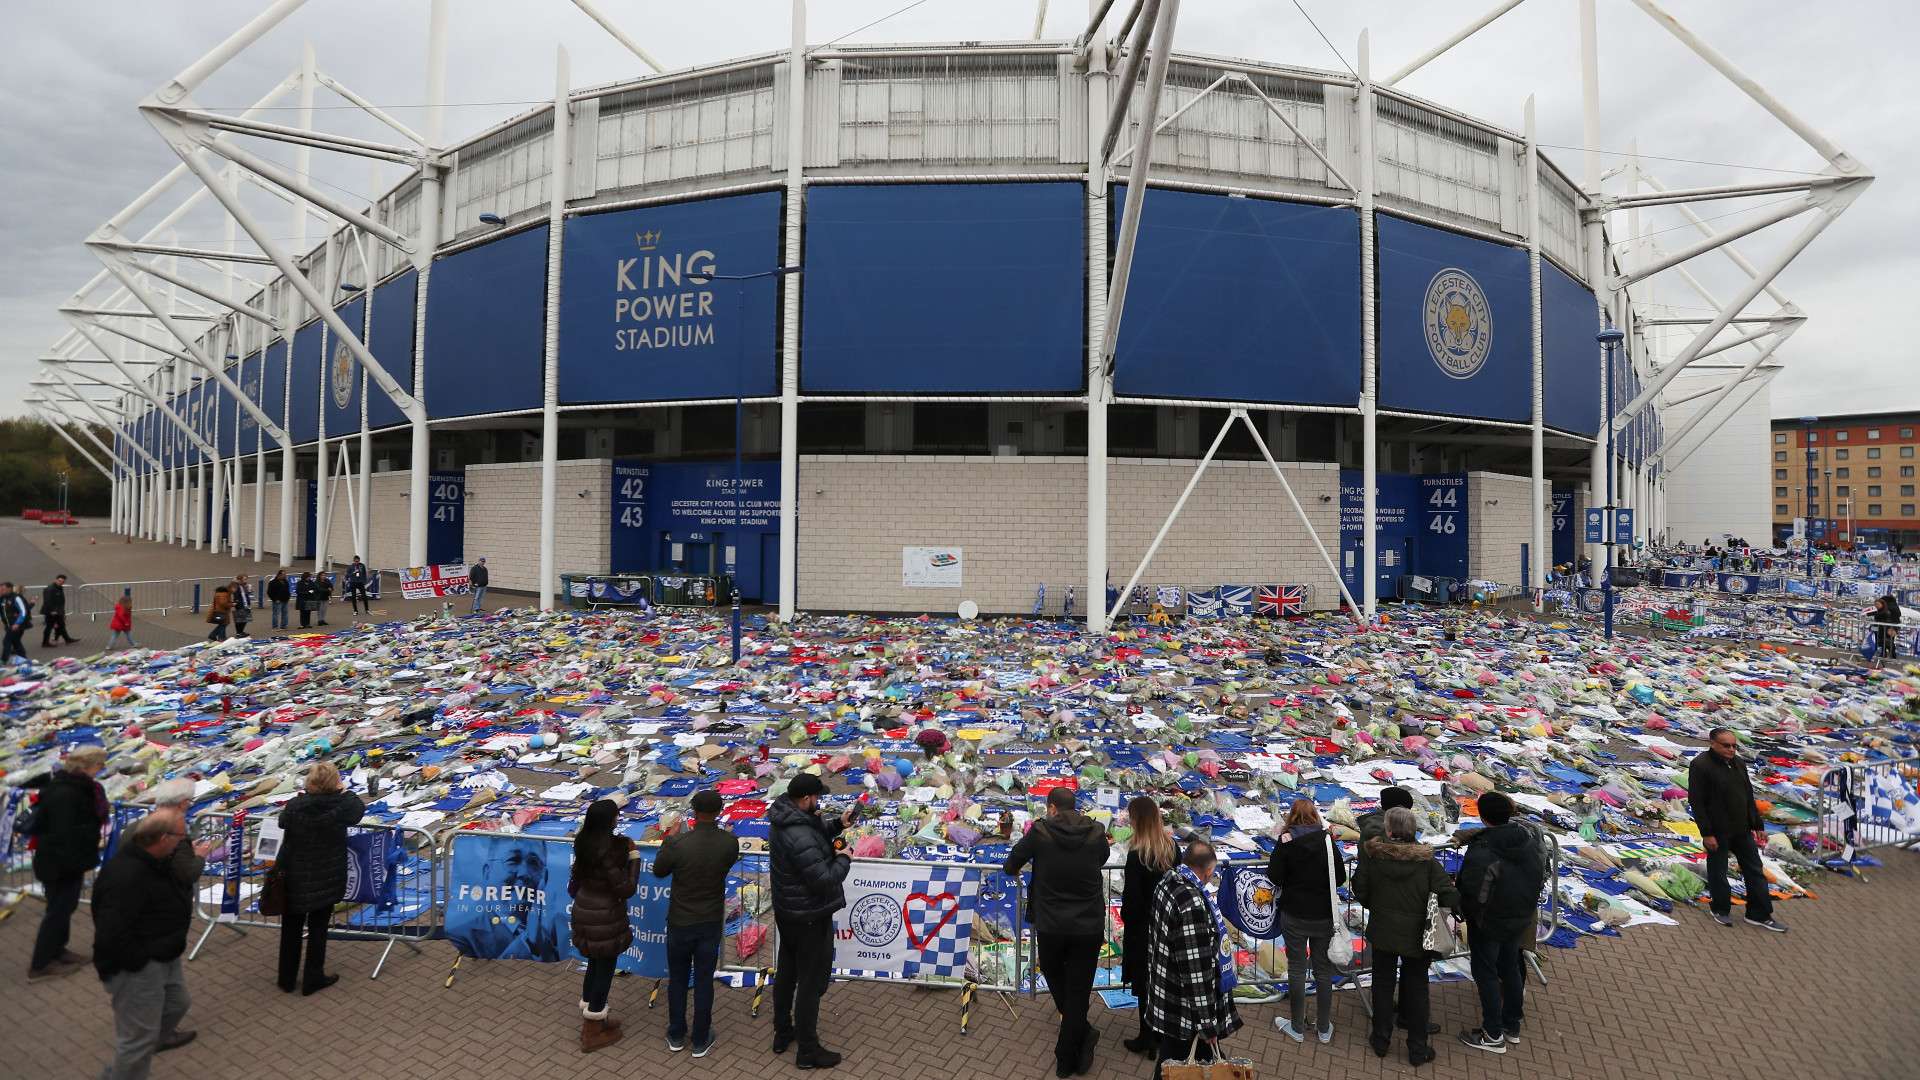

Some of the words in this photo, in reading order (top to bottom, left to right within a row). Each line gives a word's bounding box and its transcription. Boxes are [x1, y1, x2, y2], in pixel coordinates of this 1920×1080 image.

[617, 250, 716, 292] KING
[616, 291, 713, 322] POWER
[1430, 278, 1472, 314] LEICESTER
[1472, 292, 1487, 324] CITY
[615, 324, 714, 351] STADIUM
[1430, 324, 1470, 370] FOOTBALL
[1470, 332, 1487, 364] CLUB
[434, 484, 459, 500] 40
[621, 478, 643, 499] 42
[706, 479, 729, 488] KING
[1423, 478, 1464, 486] TURNSTILES
[1429, 488, 1457, 508] 44
[434, 506, 455, 522] 41
[620, 507, 643, 528] 43
[1429, 515, 1456, 534] 46
[402, 580, 448, 590] LEICESTER
[450, 576, 469, 584] CITY
[853, 879, 907, 889] CHAMPIONS
[459, 884, 547, 906] FOREVER
[509, 905, 546, 916] HEARTS
[854, 898, 889, 918] LEICESTER
[890, 903, 899, 919] CITY
[853, 922, 883, 944] FOOTBALL
[884, 924, 898, 940] CLUB
[858, 951, 891, 960] 2015/16
